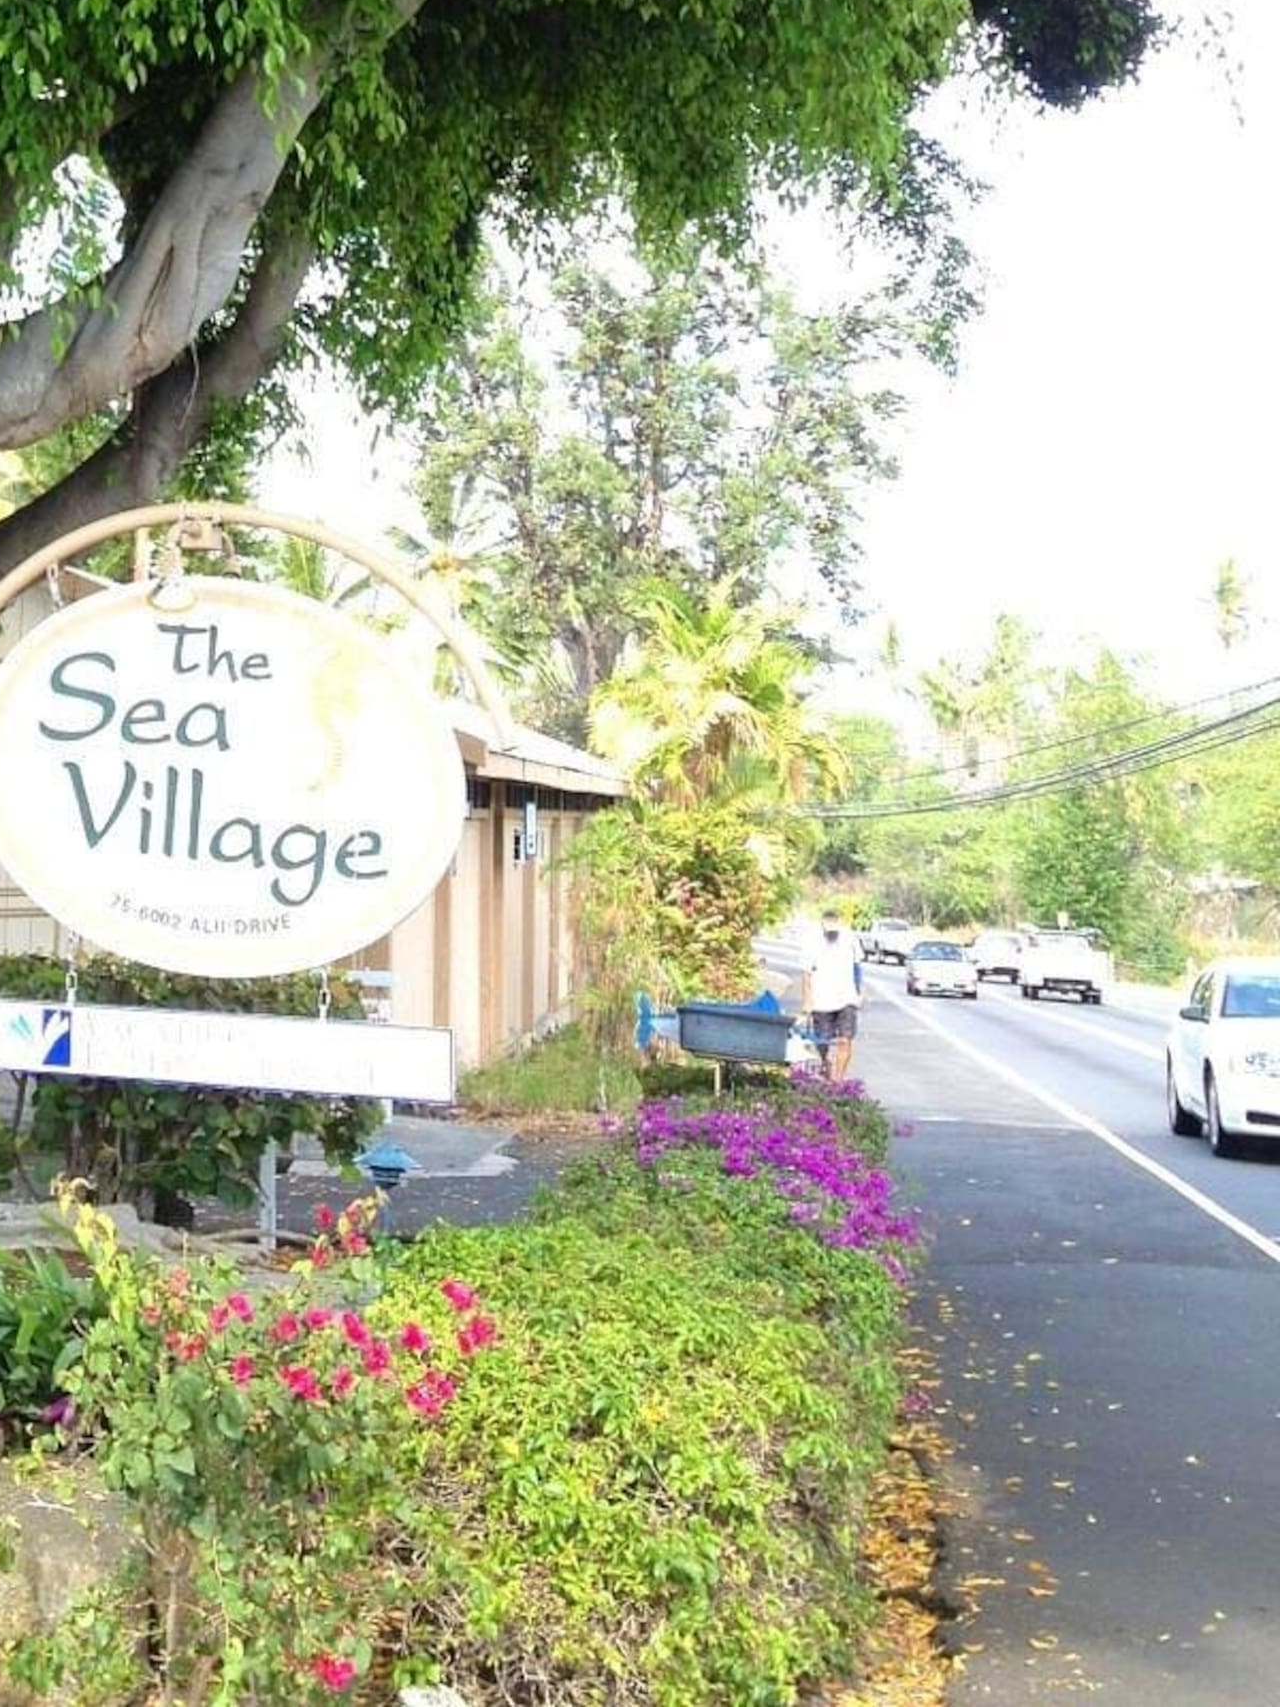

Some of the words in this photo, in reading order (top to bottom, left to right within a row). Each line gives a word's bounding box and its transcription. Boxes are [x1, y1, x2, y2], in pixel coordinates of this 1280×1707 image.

[158, 623, 272, 682] The
[38, 652, 230, 751] Sea
[63, 761, 389, 906] Village
[234, 912, 292, 935] DRIVE
